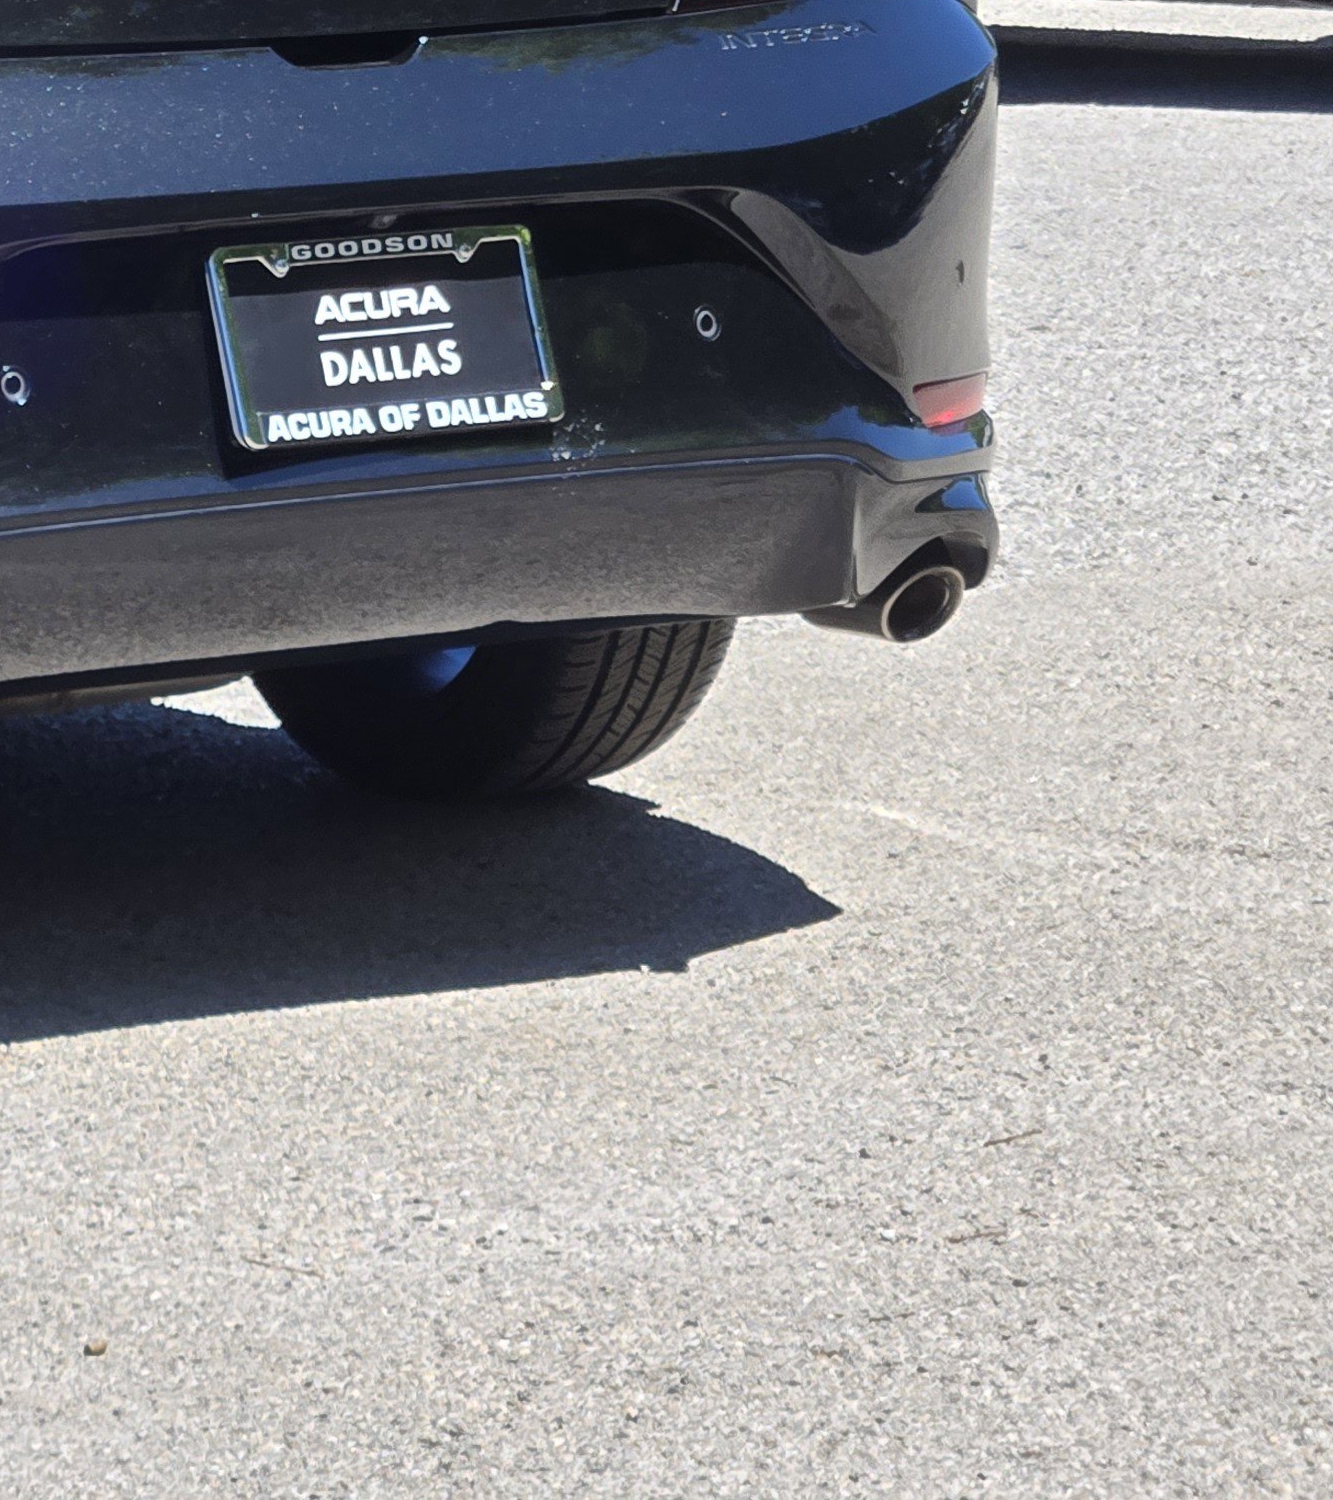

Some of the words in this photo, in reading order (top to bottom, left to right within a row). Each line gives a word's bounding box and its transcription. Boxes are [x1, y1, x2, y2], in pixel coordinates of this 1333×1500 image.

[290, 233, 454, 261] GOODSON
[314, 285, 451, 325] ACURA
[320, 339, 462, 387] DALLAS
[267, 408, 375, 443] ACURA
[378, 403, 421, 432] OF
[425, 390, 548, 428] DALLAS
